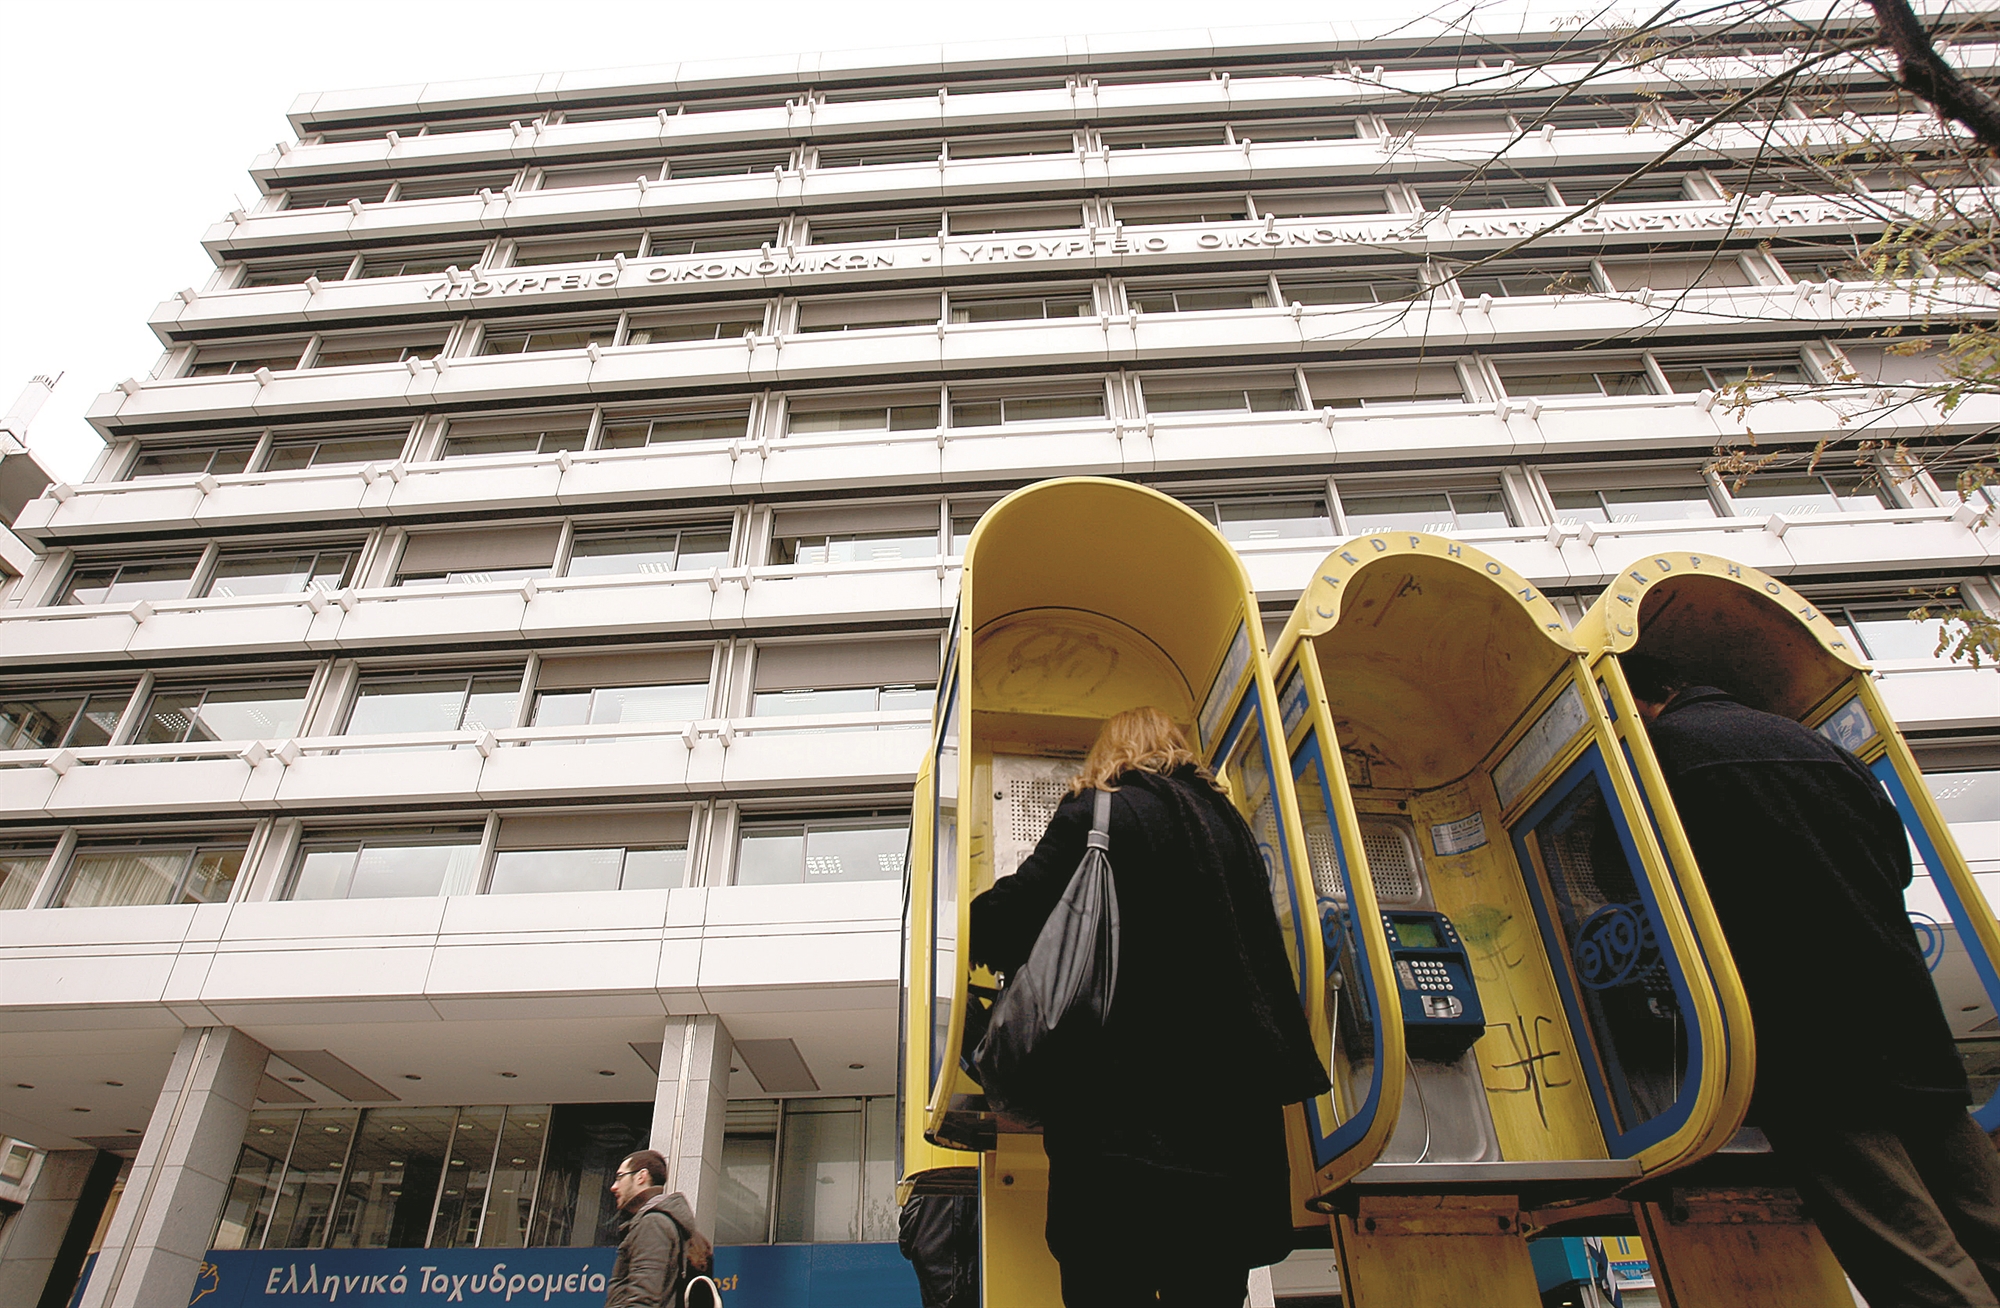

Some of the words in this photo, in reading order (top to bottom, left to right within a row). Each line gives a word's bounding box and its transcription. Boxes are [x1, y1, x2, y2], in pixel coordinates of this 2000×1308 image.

[424, 272, 617, 299] ΥΠΟΥΡΓΕΙΟ
[646, 252, 895, 281] ΟΙΚΟΝΟΜΙΚΩΝ
[959, 237, 1169, 262] ΥΠΟΥΡΓΕΙΟ
[1197, 225, 1428, 248] ΟΙΚΟΝΟΜΙΑΣ
[1317, 536, 1563, 632] CARDPHONE
[1617, 556, 1847, 650] CARDPHONE
[265, 1263, 407, 1302] Ελληνικά
[420, 1262, 606, 1302] Ταχυδρομεία
[713, 1274, 739, 1291] ost
